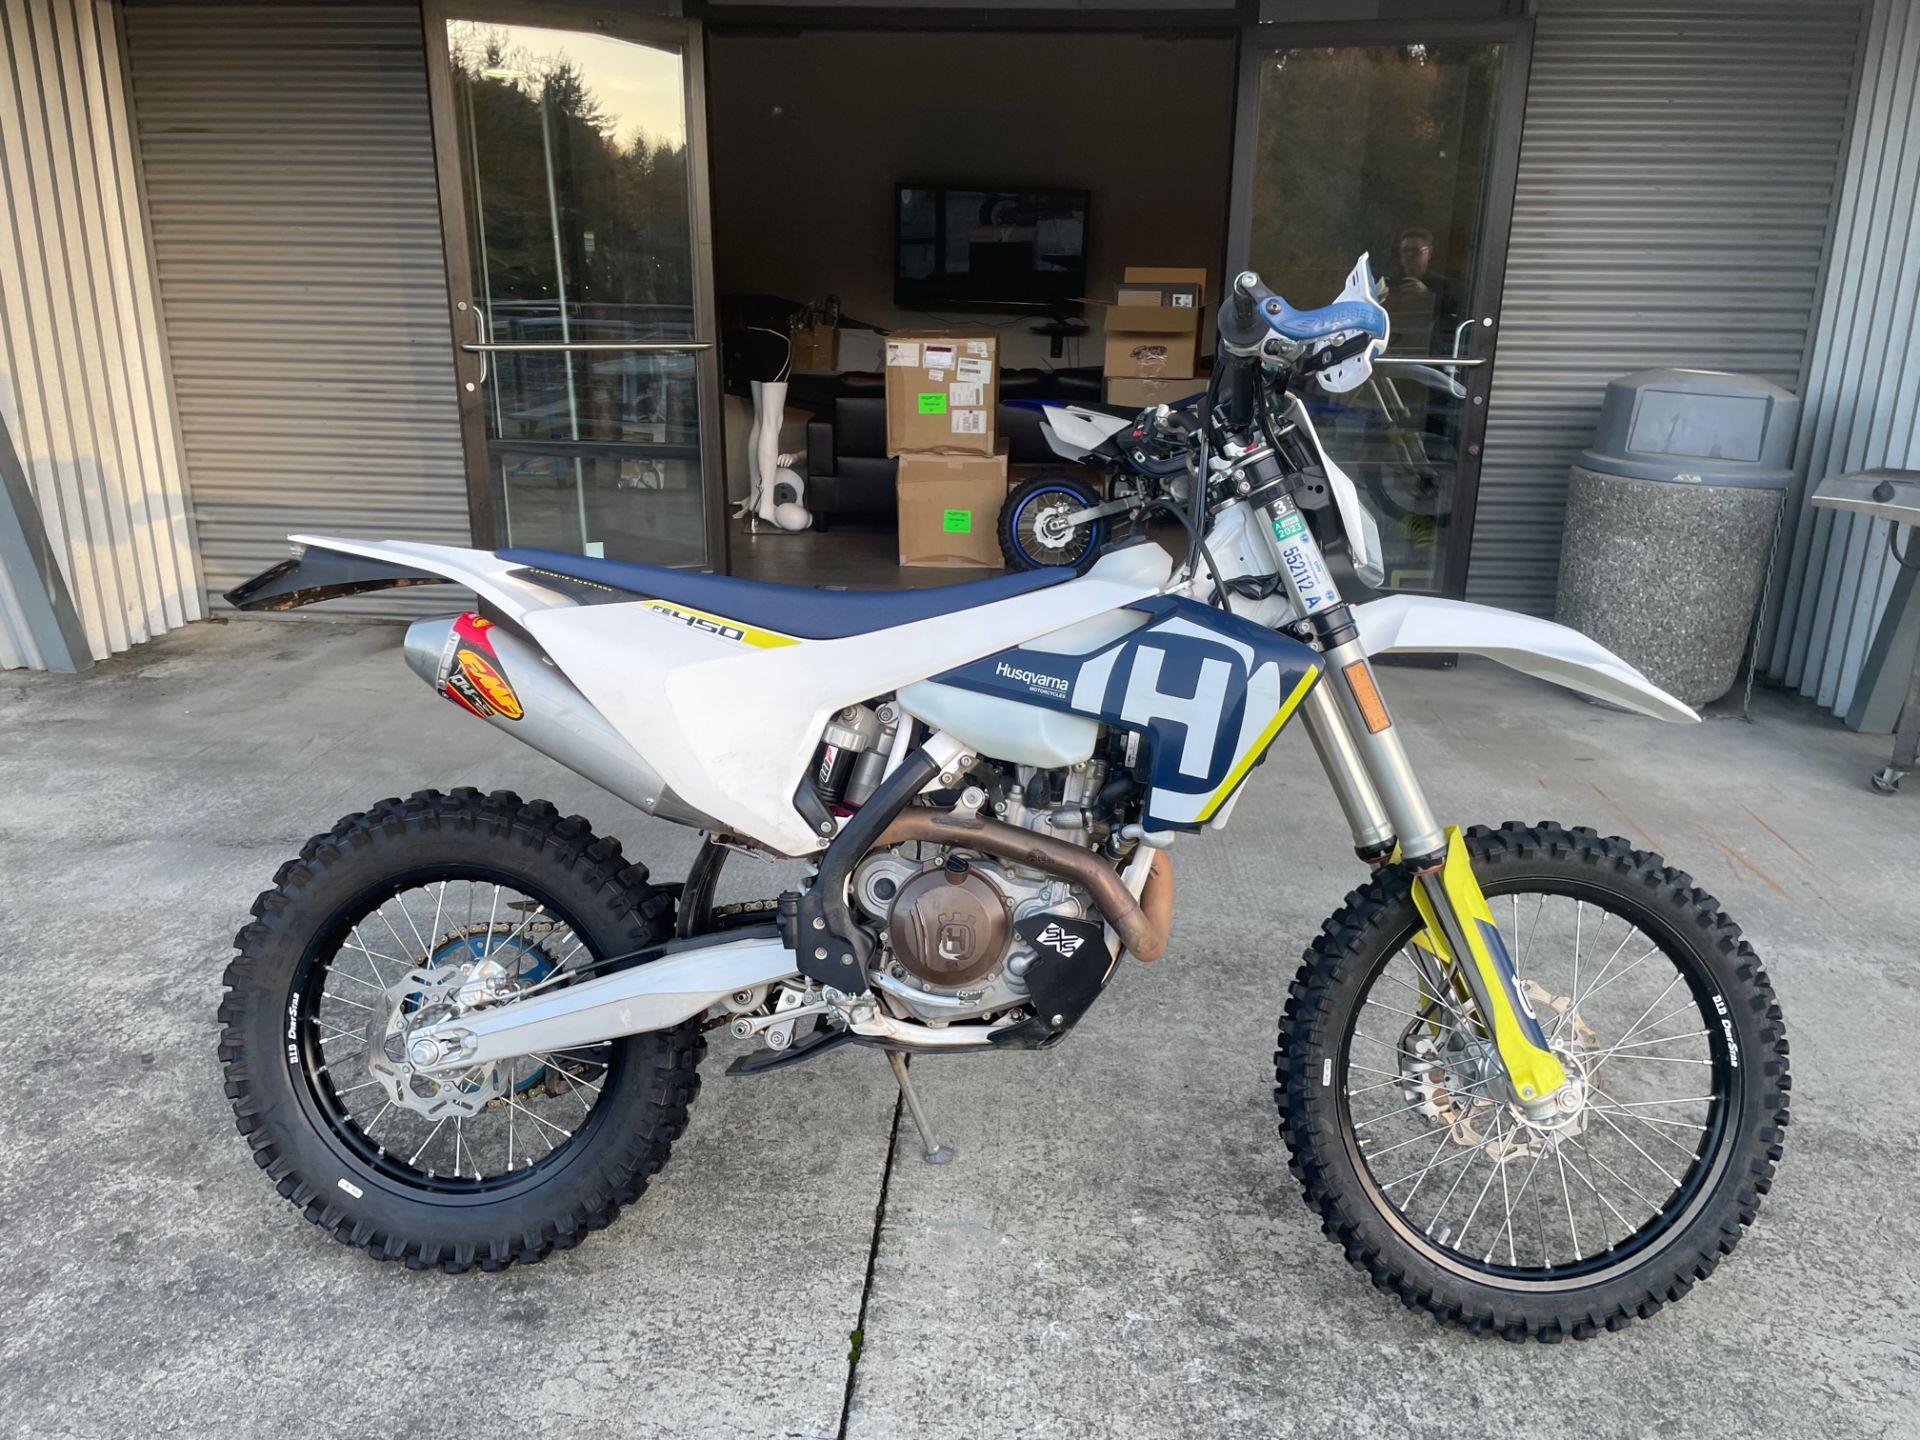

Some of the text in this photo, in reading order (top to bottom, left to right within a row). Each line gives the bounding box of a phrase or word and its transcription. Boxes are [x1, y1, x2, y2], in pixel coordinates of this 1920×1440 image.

[1273, 500, 1287, 514] 3
[1283, 546, 1314, 592] 552112
[1305, 596, 1322, 609] A
[457, 651, 524, 717] FMF
[995, 661, 1069, 691] Husqvarna
[1029, 686, 1066, 699] MOTORCYCLES
